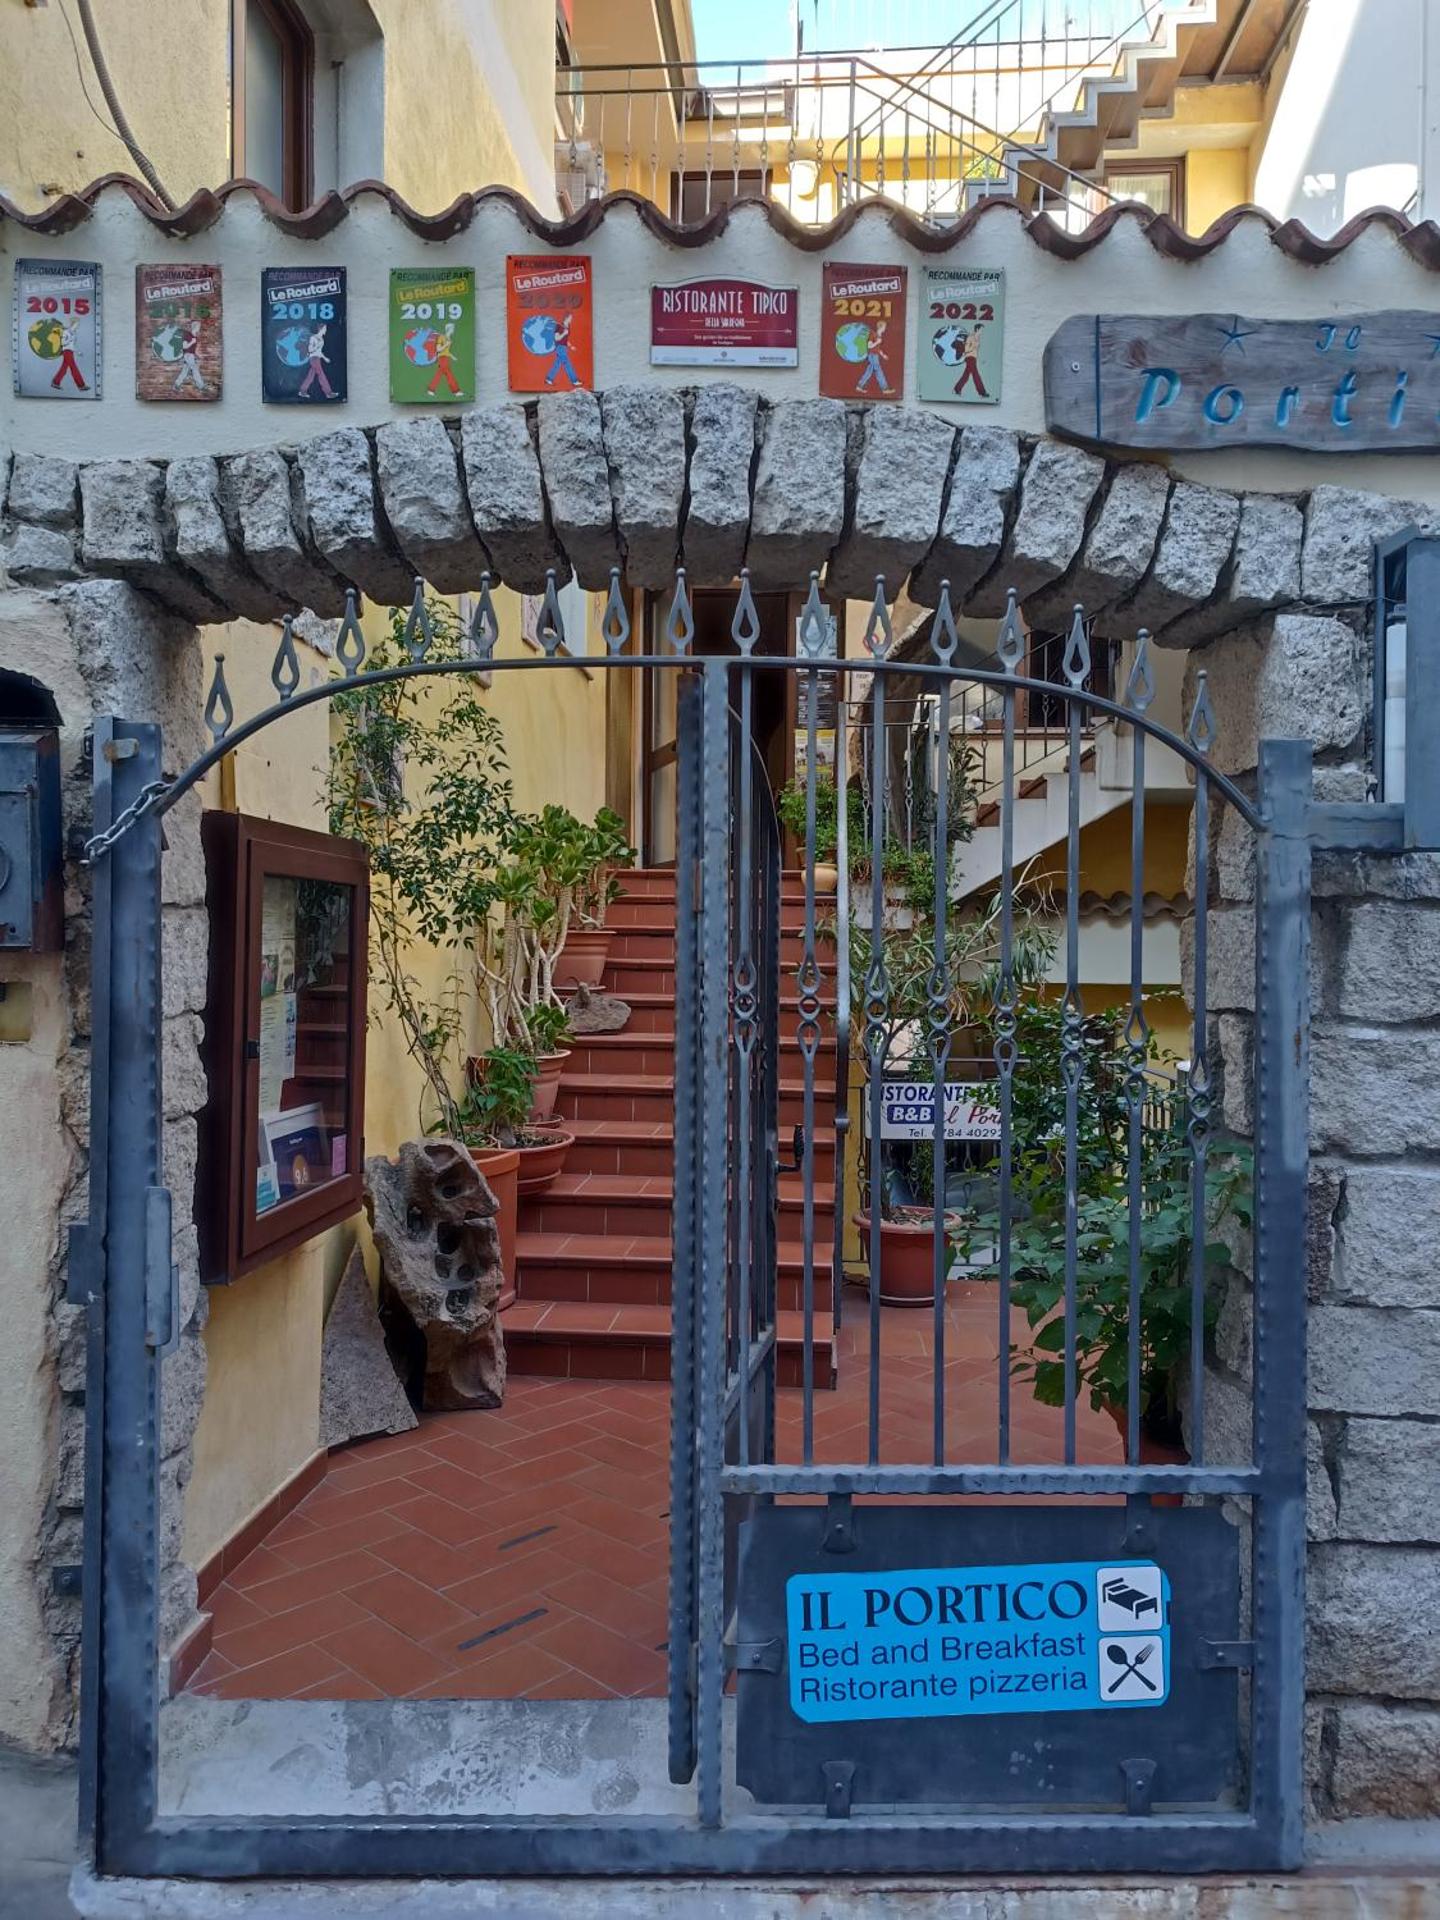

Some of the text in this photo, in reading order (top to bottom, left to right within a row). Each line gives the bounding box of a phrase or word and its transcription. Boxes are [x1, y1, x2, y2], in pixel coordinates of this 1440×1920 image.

[26, 277, 91, 293] Le Routard
[516, 270, 583, 289] Le Routard
[983, 271, 1000, 282] PAR
[147, 280, 211, 299] Le Routard
[271, 280, 337, 300] Le Routard
[399, 280, 465, 301] Le Routard
[832, 280, 898, 297] Le Routard
[930, 282, 996, 300] Le Routard
[27, 296, 90, 315] 2015
[272, 302, 334, 320] 2018
[400, 303, 462, 320] 2019
[663, 290, 787, 314] RISTORANTE TIPICO
[834, 299, 892, 318] 2021
[929, 302, 994, 321] 2022
[1135, 367, 1440, 430] Porti
[892, 1107, 932, 1121] B&B
[800, 1580, 1088, 1631] IL PORTICO
[799, 1632, 1086, 1668] Bed and Breakfast
[800, 1666, 1088, 1703] Ristorante pizzeria
